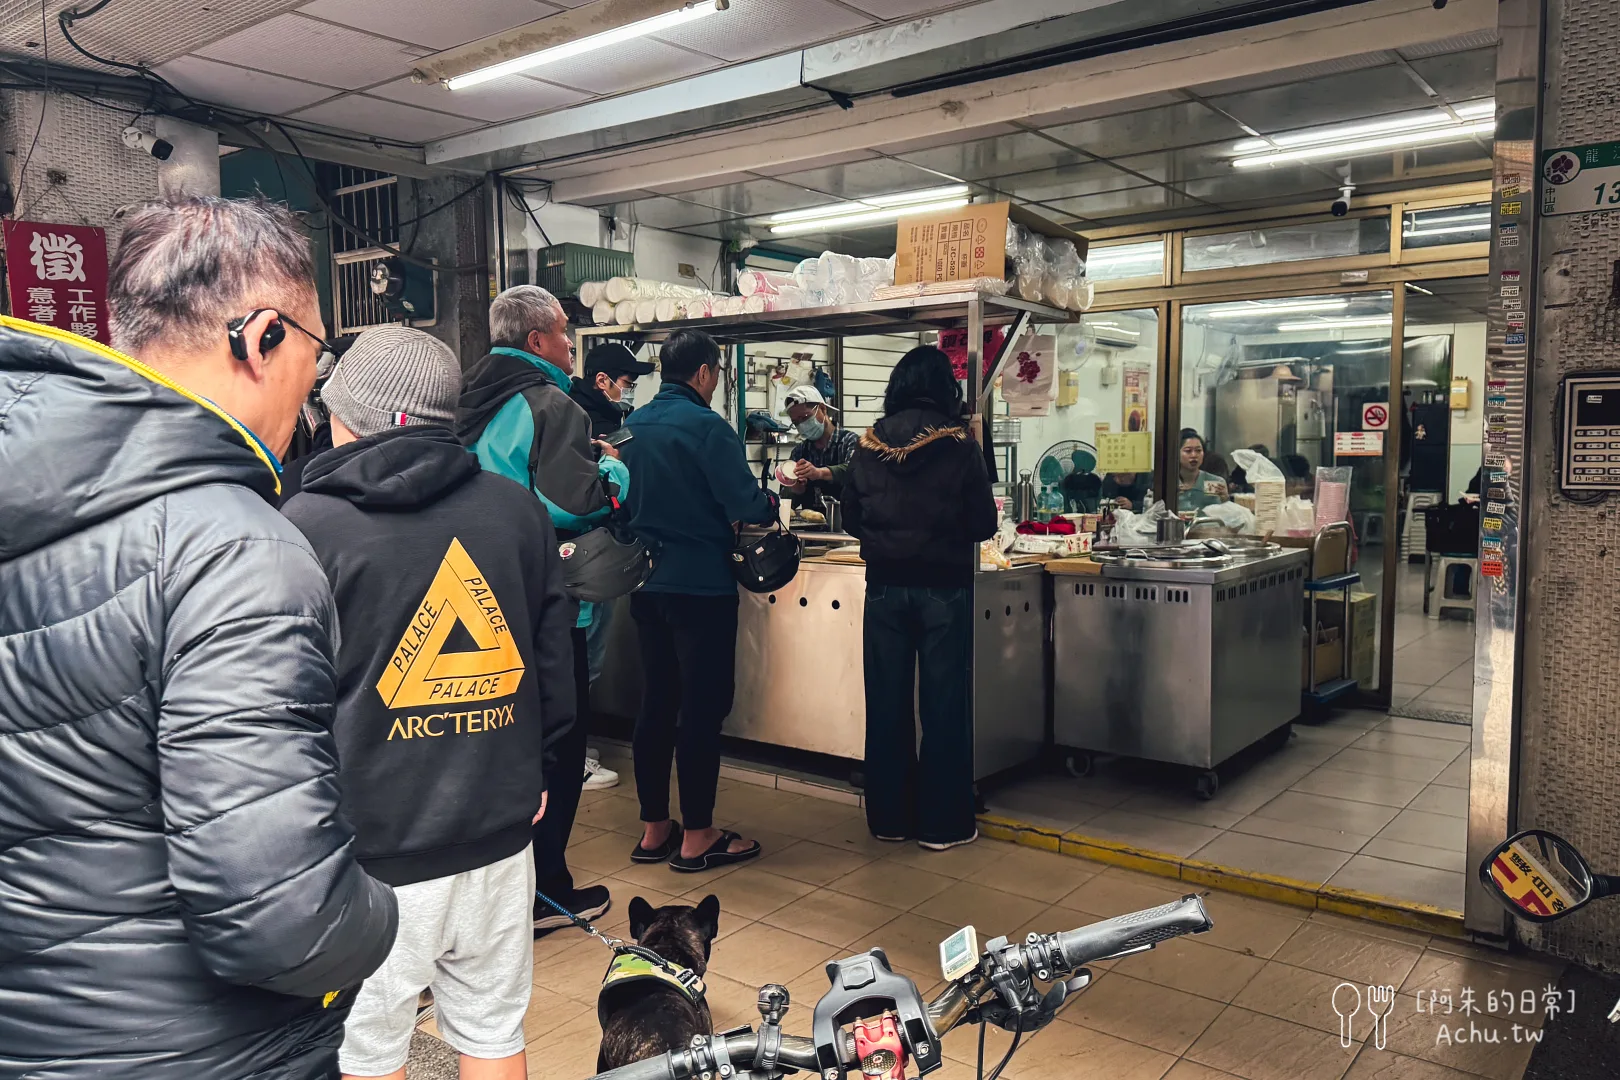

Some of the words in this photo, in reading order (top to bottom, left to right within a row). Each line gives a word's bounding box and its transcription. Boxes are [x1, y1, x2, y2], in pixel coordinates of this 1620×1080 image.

[1544, 187, 1556, 214] 中山區
[29, 231, 87, 283] 徵
[949, 246, 957, 276] JC-520
[26, 286, 58, 329] 意者
[463, 577, 507, 634] PALACE
[392, 601, 438, 673] PALACE
[429, 677, 500, 700] PALACE
[387, 703, 515, 741] ARC'TERYX
